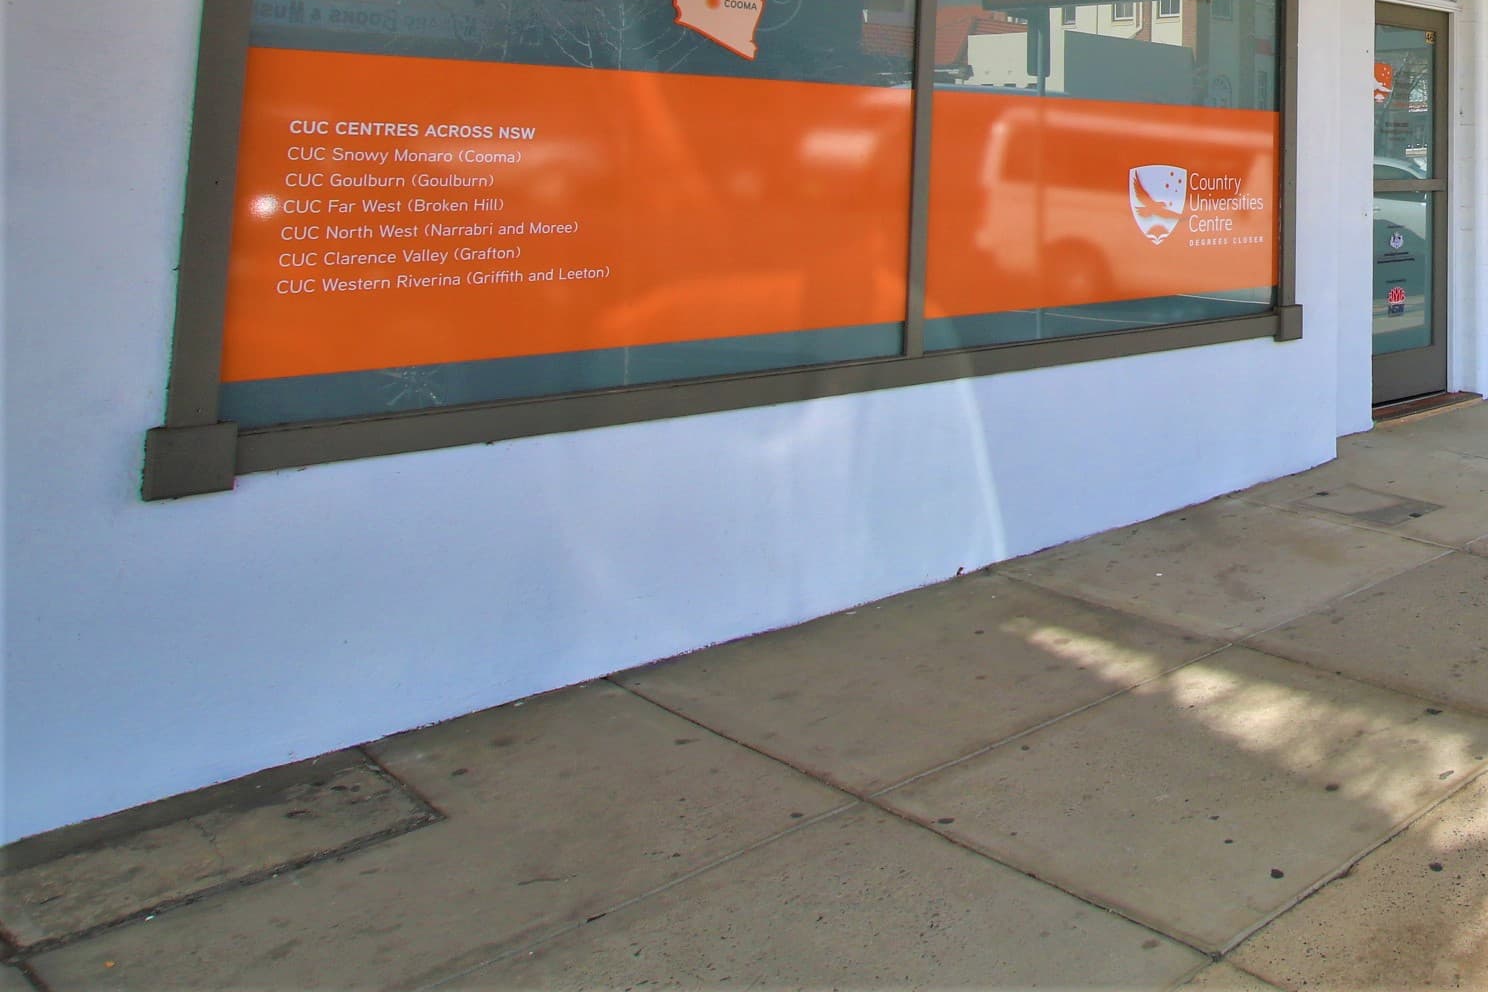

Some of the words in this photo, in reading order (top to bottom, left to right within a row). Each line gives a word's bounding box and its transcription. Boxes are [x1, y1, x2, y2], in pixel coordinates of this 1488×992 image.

[723, 0, 758, 10] COOMA
[289, 120, 328, 135] CUC
[335, 121, 419, 137] CENTRES
[425, 124, 493, 139] ACROSS
[498, 126, 536, 140] NSW
[287, 146, 326, 161] CUC
[332, 147, 389, 166] Snowy
[394, 148, 453, 163] Monaro
[458, 149, 522, 164] (Cooma)
[285, 173, 324, 187] CUC
[330, 173, 405, 188] Goulburn
[411, 173, 495, 188] (Goulburn)
[1189, 172, 1242, 196] Country
[283, 199, 322, 214] CUC
[328, 199, 357, 213] Far
[362, 199, 402, 213] West
[407, 198, 468, 213] (Broken
[473, 198, 504, 212] Hill)
[1188, 193, 1264, 212] Universities
[281, 226, 320, 240] CUC
[326, 225, 373, 239] North
[379, 224, 419, 238] West
[424, 222, 493, 237] (Narrabri
[498, 222, 524, 236] and
[529, 221, 579, 235] Moree)
[1188, 214, 1233, 233] Centre
[278, 252, 318, 267] CUC
[324, 250, 397, 266] Clarence
[402, 248, 449, 265] Valley
[454, 246, 521, 261] (Grafton)
[276, 278, 316, 294] CUC
[322, 277, 391, 292] Western
[397, 272, 461, 288] Riverina
[466, 270, 524, 286] (Griffith
[528, 268, 554, 282] and
[559, 265, 611, 281] Leeton)
